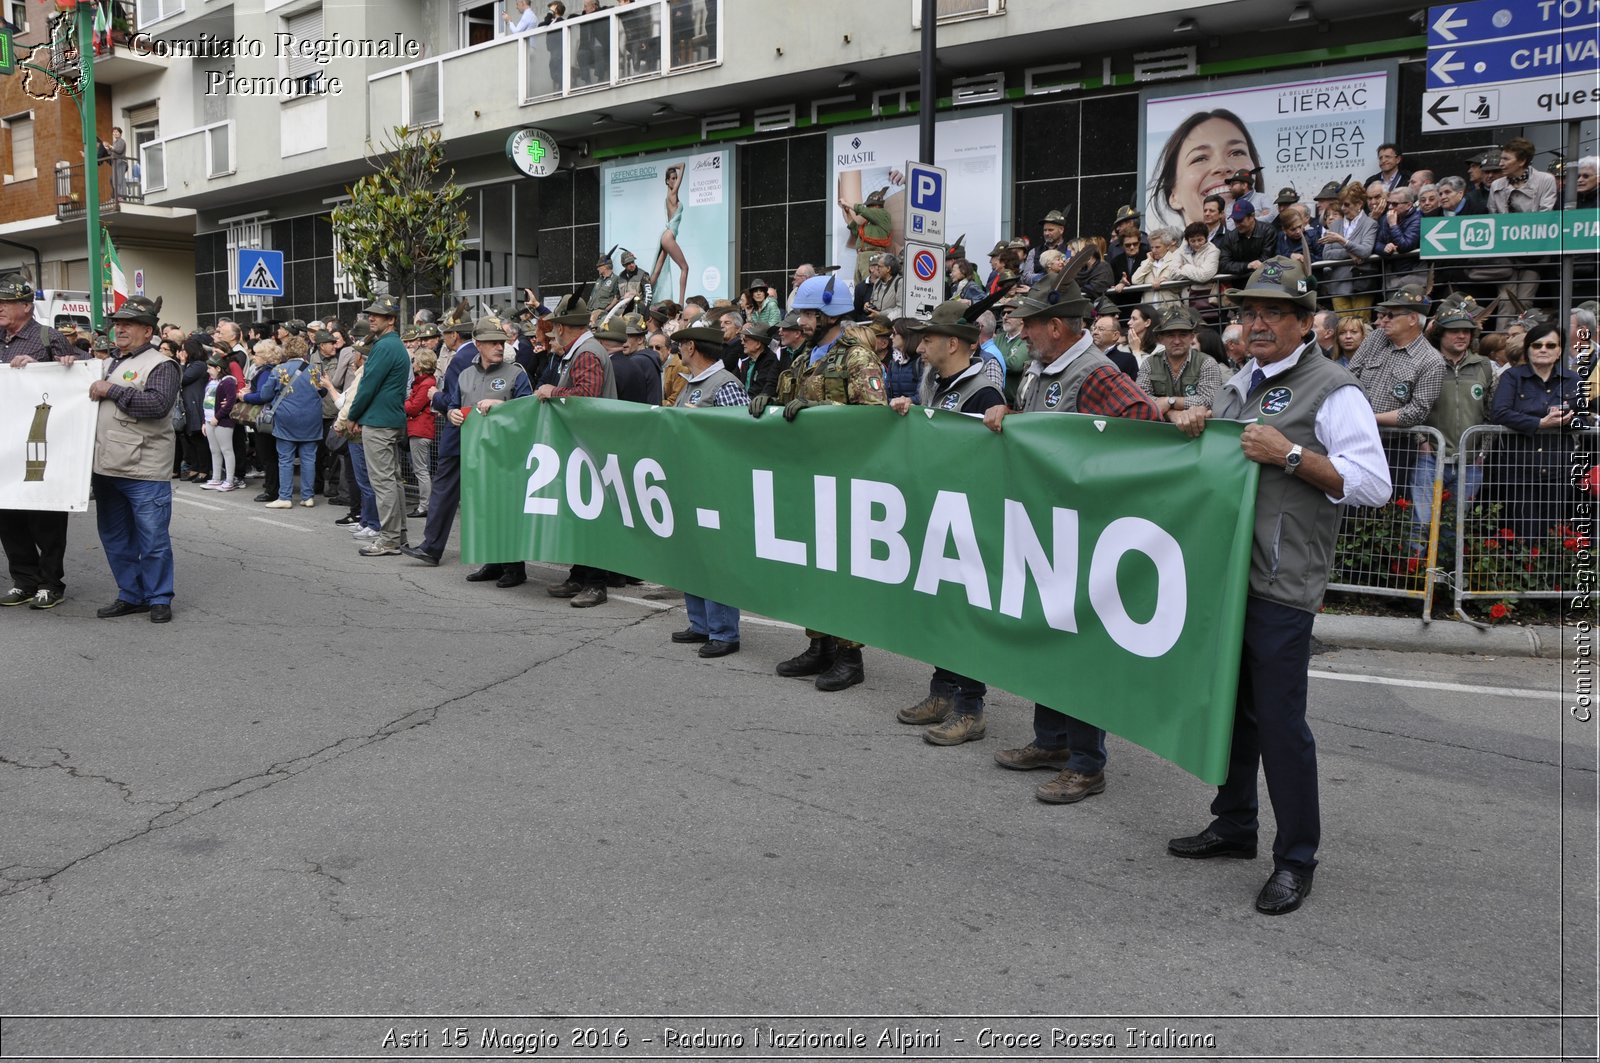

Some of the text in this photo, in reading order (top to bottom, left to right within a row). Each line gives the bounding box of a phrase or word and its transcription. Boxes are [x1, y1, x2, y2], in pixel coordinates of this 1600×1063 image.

[1510, 39, 1600, 69] CHIVA
[1278, 88, 1367, 114] LIERAC
[1289, 87, 1322, 96] BELLEZZA
[1537, 87, 1600, 112] ques
[1276, 119, 1366, 132] IDRATAZIONE OSSIGENANTE
[1277, 125, 1365, 147] HYDRA
[513, 130, 535, 155] FARMACIA
[1276, 141, 1365, 163] GENIST
[837, 150, 877, 166] RILASTIL
[639, 165, 657, 176] BODY
[917, 175, 936, 204] P
[1465, 227, 1489, 242] A21
[1501, 224, 1559, 241] TORINO
[523, 443, 1188, 658] 2016 - LIBANO
